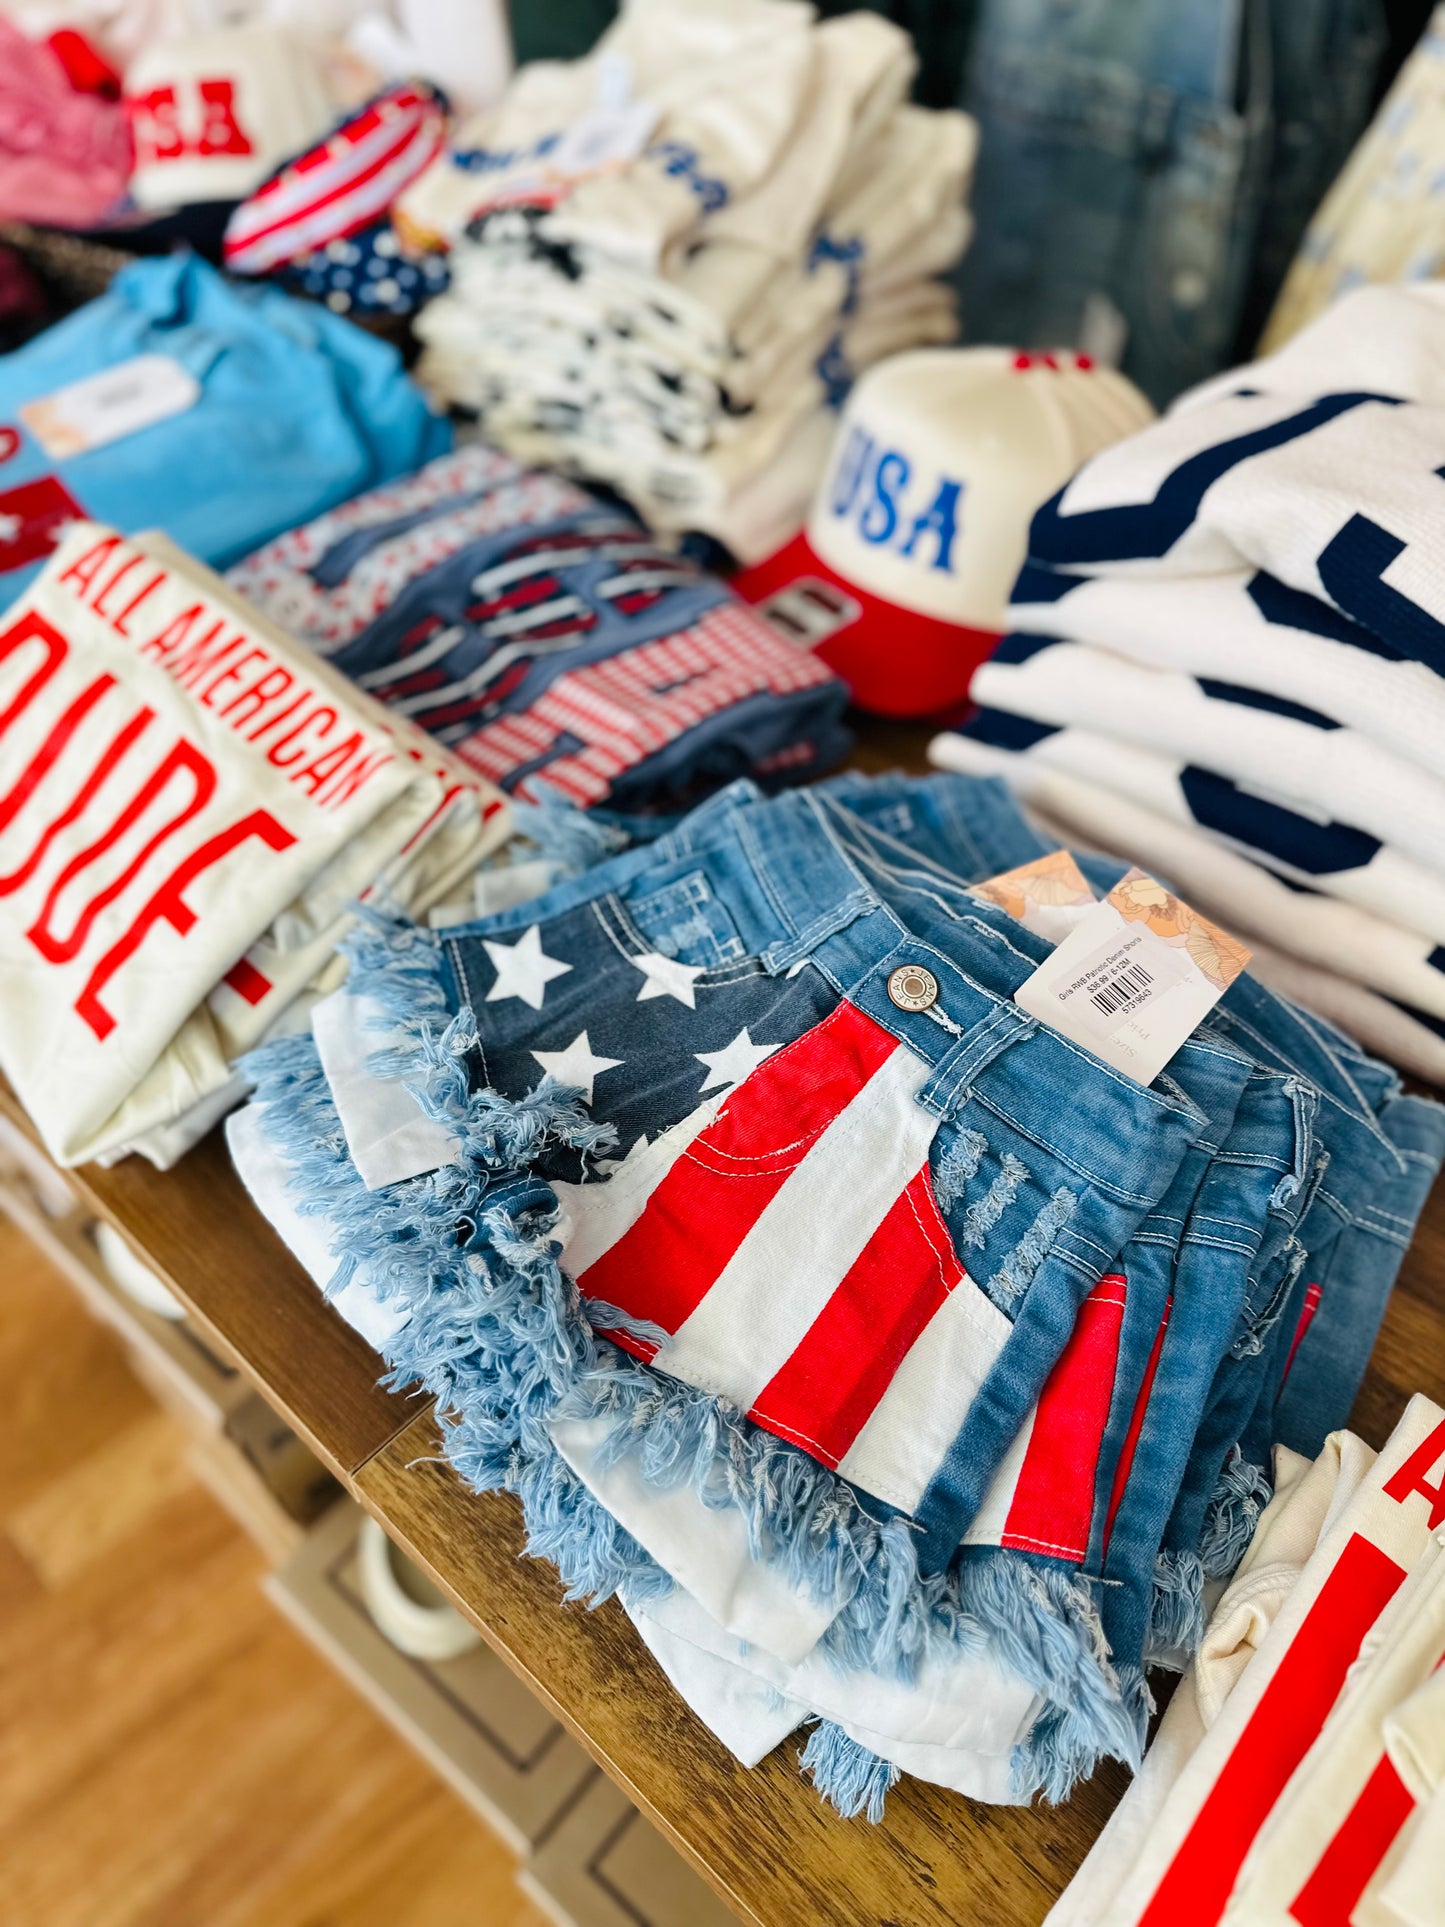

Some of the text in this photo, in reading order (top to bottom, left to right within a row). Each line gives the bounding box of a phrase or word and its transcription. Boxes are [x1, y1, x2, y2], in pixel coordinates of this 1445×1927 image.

[831, 427, 963, 573] USA
[58, 535, 168, 637] ALL
[141, 603, 396, 811] AMERICAN
[893, 969, 911, 1005] JEANS
[916, 970, 935, 1006] JEANS
[1058, 937, 1142, 1001] Girls RWB Patriotic Denim Shorts
[1110, 957, 1132, 976] 6-12M
